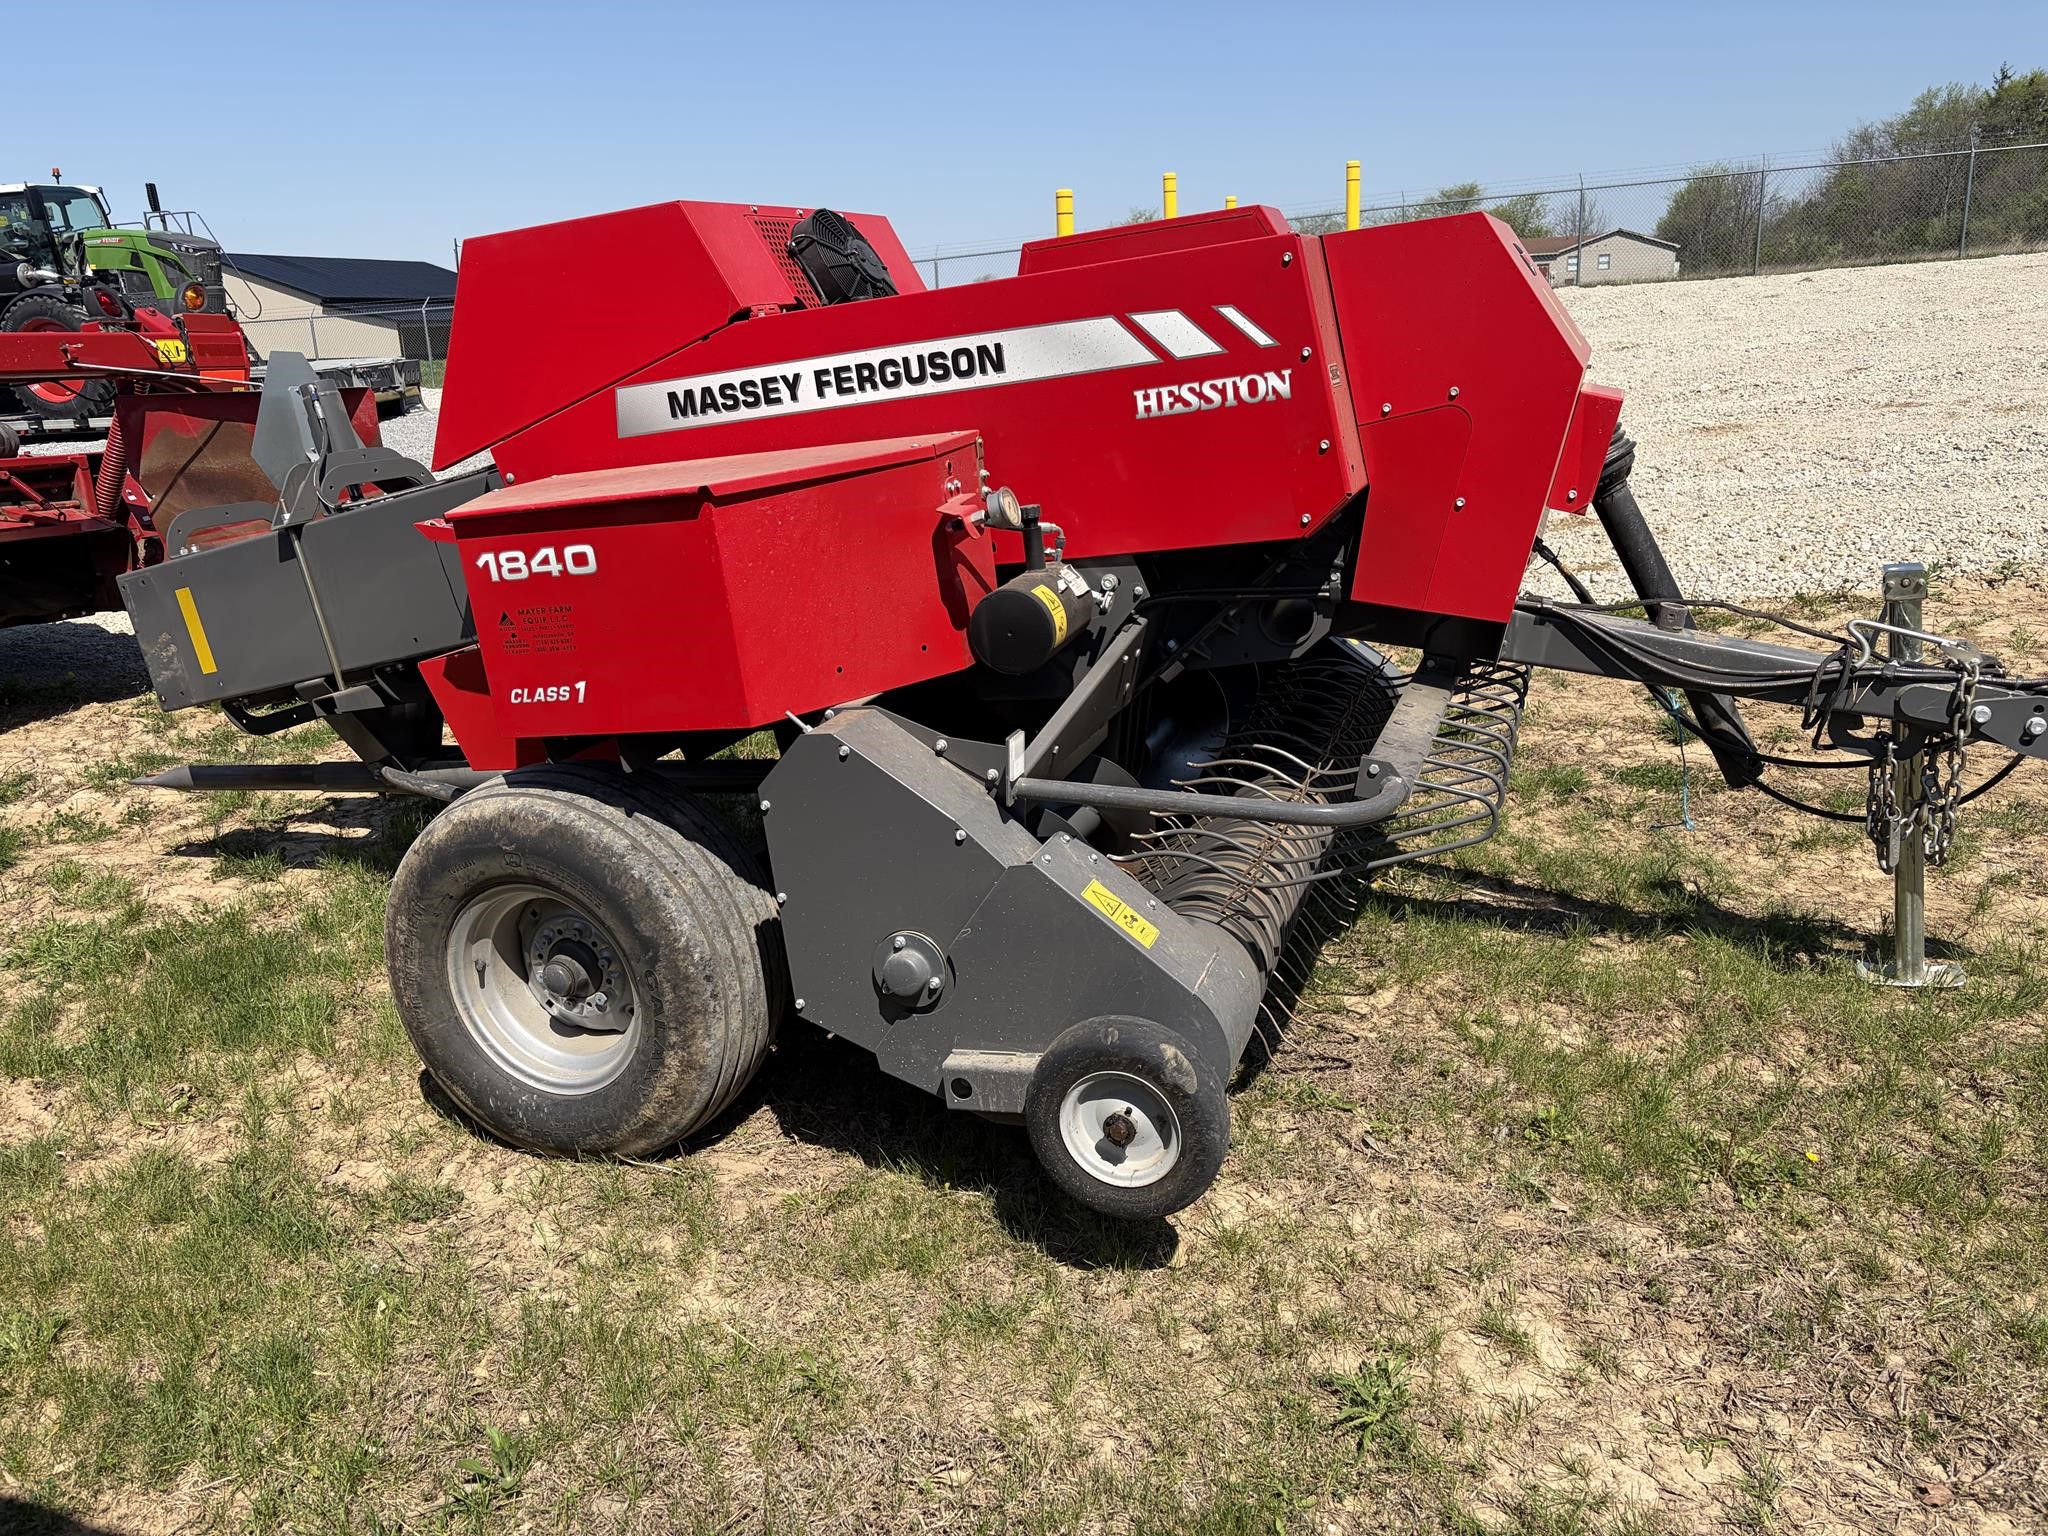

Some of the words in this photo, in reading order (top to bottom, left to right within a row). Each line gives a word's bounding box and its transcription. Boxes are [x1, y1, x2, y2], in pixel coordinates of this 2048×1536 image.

[667, 373, 802, 419] MASSEY
[814, 342, 1006, 400] FERGUSON
[1133, 368, 1292, 419] HESSTON
[476, 544, 597, 582] 1840
[518, 607, 546, 615] MAYER
[549, 605, 572, 614] FARM
[511, 686, 570, 704] CLASS
[574, 680, 587, 704] 1
